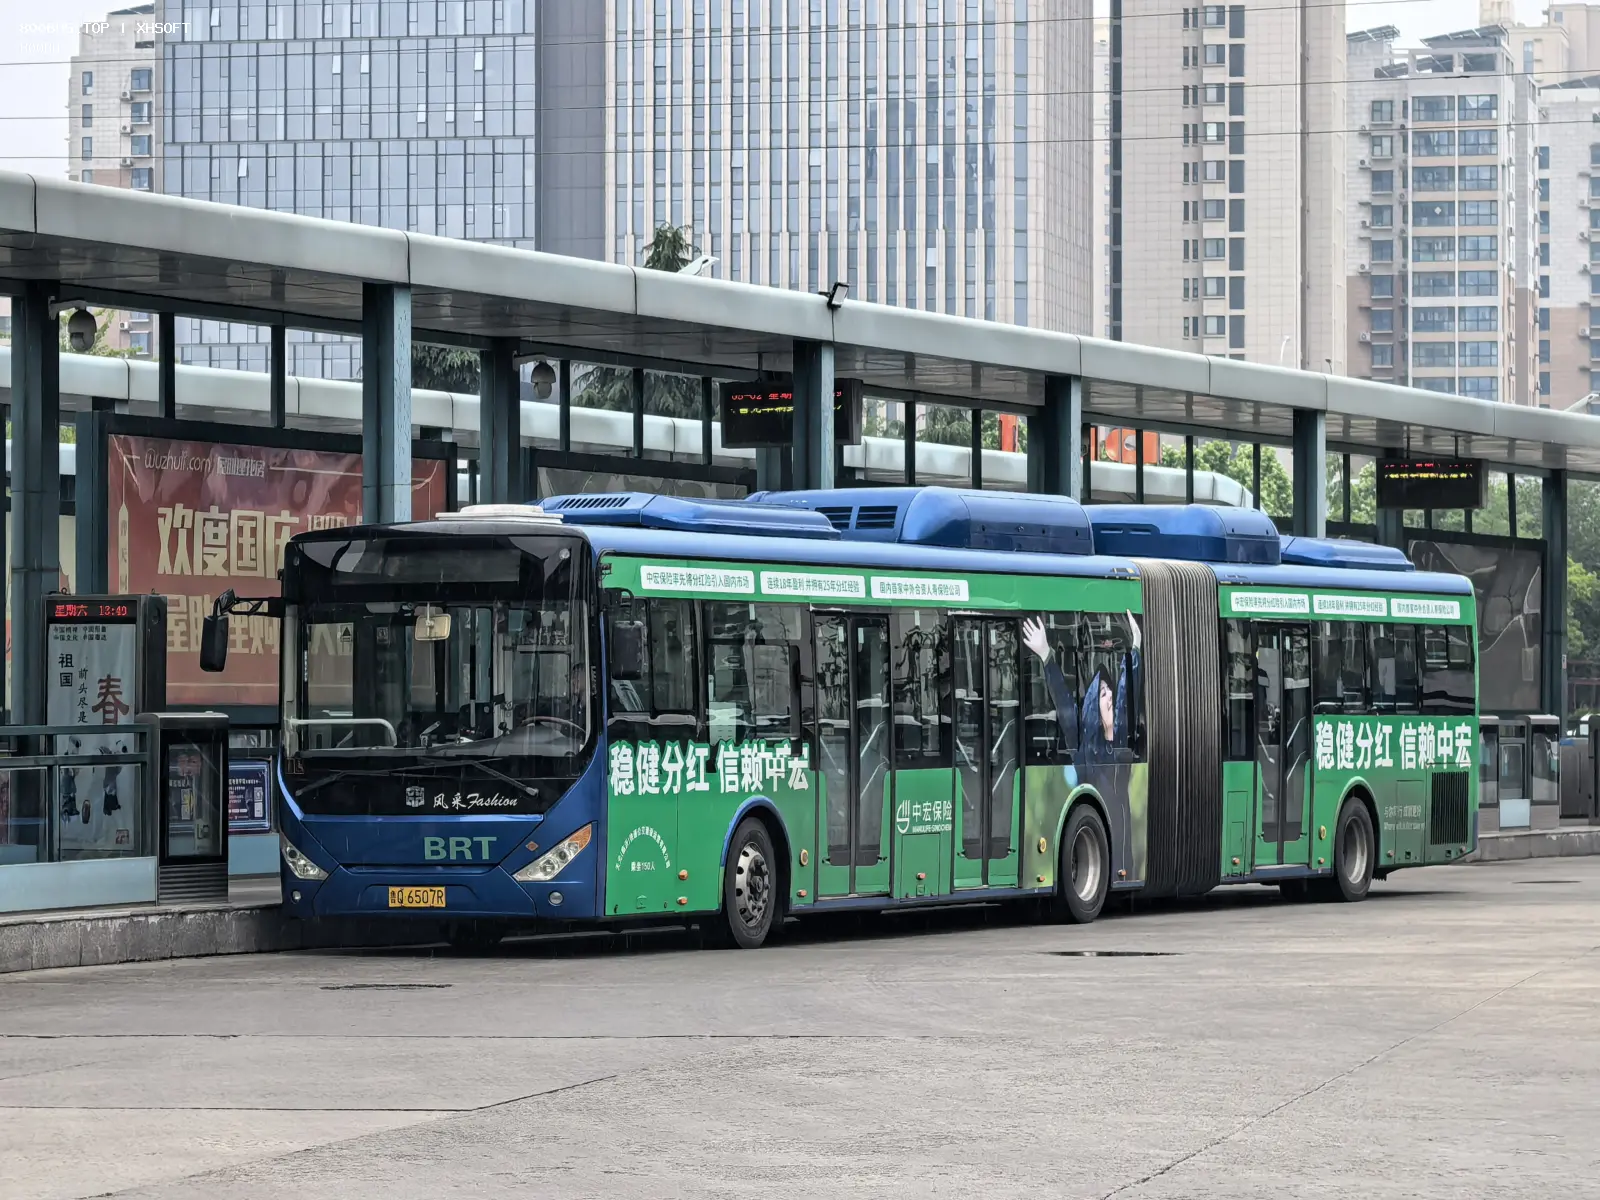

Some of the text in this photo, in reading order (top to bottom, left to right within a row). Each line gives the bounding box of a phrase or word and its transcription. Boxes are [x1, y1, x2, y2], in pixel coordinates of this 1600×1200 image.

[55, 604, 88, 617] 星期六
[58, 653, 74, 688] 祖国
[92, 673, 130, 725] 春
[1315, 720, 1473, 770] 稳健分红 信赖中宏
[609, 742, 810, 797] 稳健分红 信赖中宏
[466, 792, 518, 809] Fashion
[912, 800, 953, 822] 中宏保险
[423, 836, 497, 860] BRT
